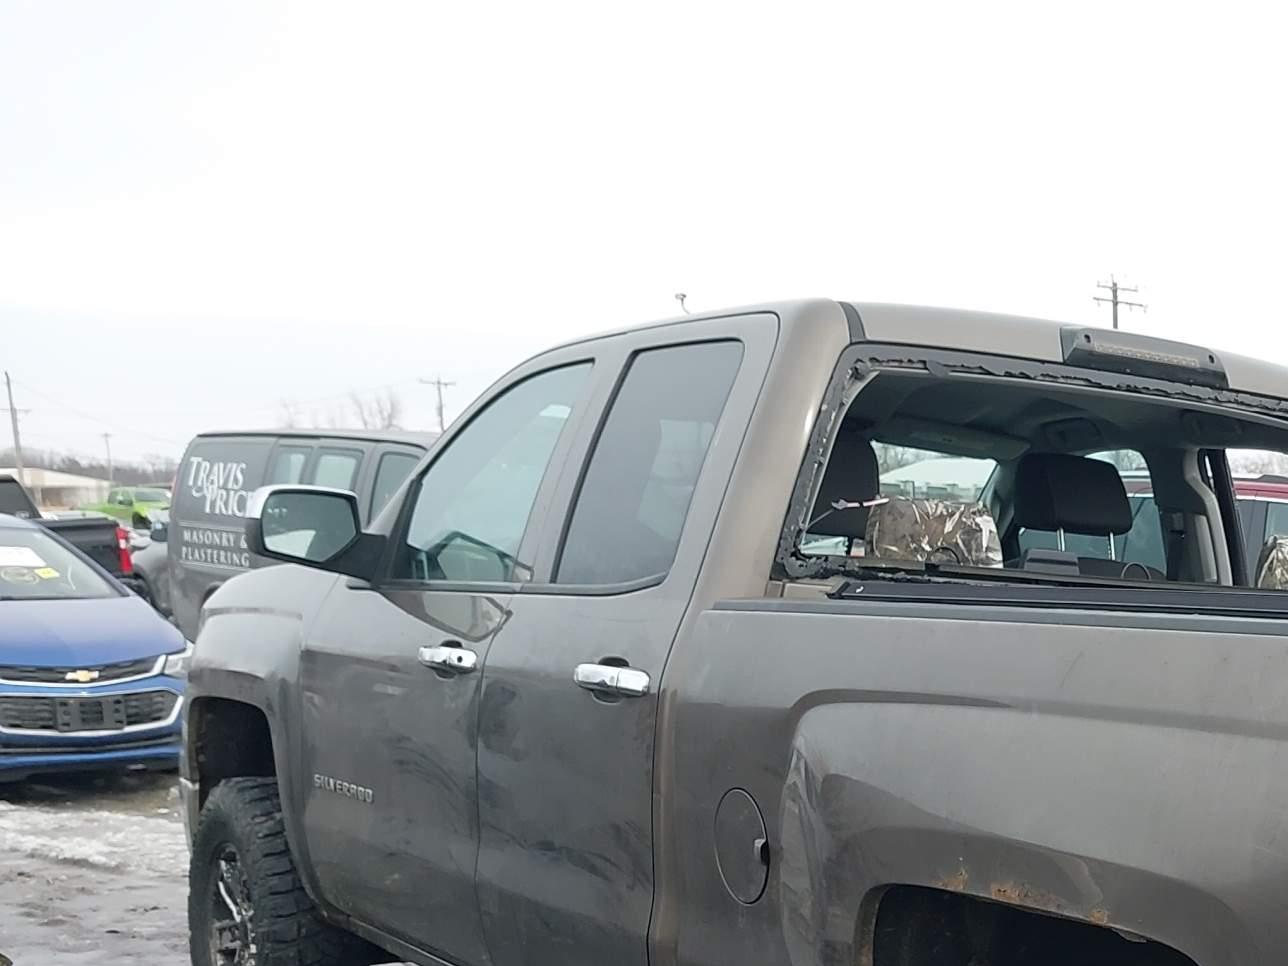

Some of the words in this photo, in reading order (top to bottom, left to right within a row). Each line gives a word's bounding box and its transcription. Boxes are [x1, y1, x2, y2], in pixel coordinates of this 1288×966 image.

[187, 456, 247, 491] TRAVIS
[183, 529, 235, 547] MASONRY
[239, 534, 249, 549] &
[181, 546, 250, 568] PLASTERING
[313, 773, 374, 803] SILVERADO
